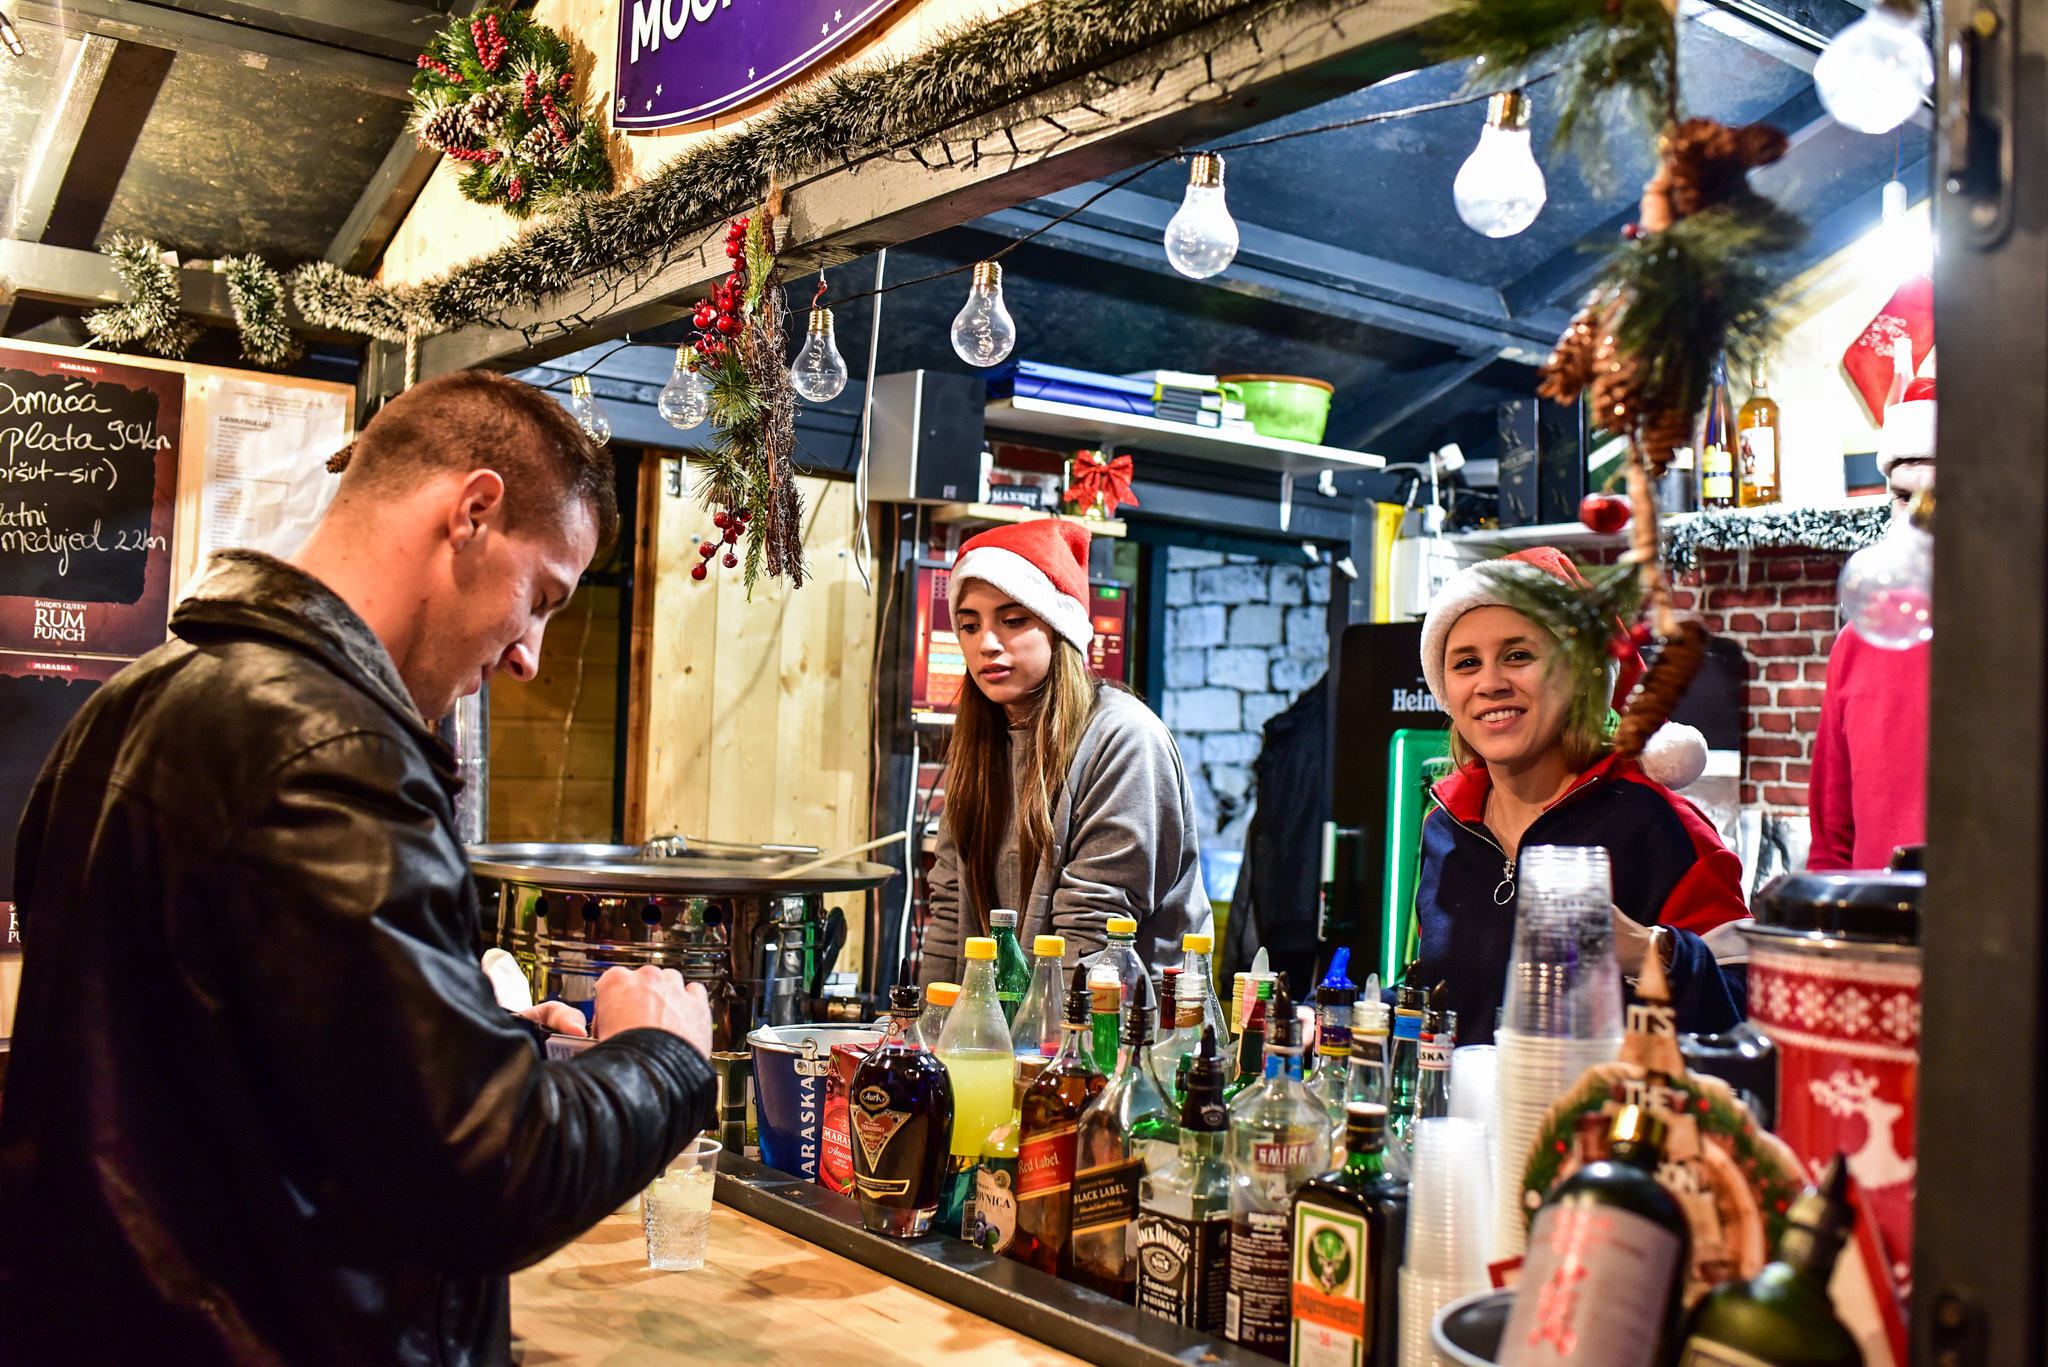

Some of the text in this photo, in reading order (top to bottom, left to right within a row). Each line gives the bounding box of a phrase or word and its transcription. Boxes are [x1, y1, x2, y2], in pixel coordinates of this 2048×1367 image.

[0, 421, 105, 466] plata
[991, 490, 1039, 506] MAXBET
[114, 527, 166, 552] 22kn
[63, 603, 87, 611] QUEEN
[35, 608, 86, 630] RUM
[33, 626, 86, 642] PUNCH
[33, 662, 72, 672] MARASKA
[1018, 1152, 1059, 1174] Red Label
[1073, 1184, 1128, 1204] BLACK LABEL
